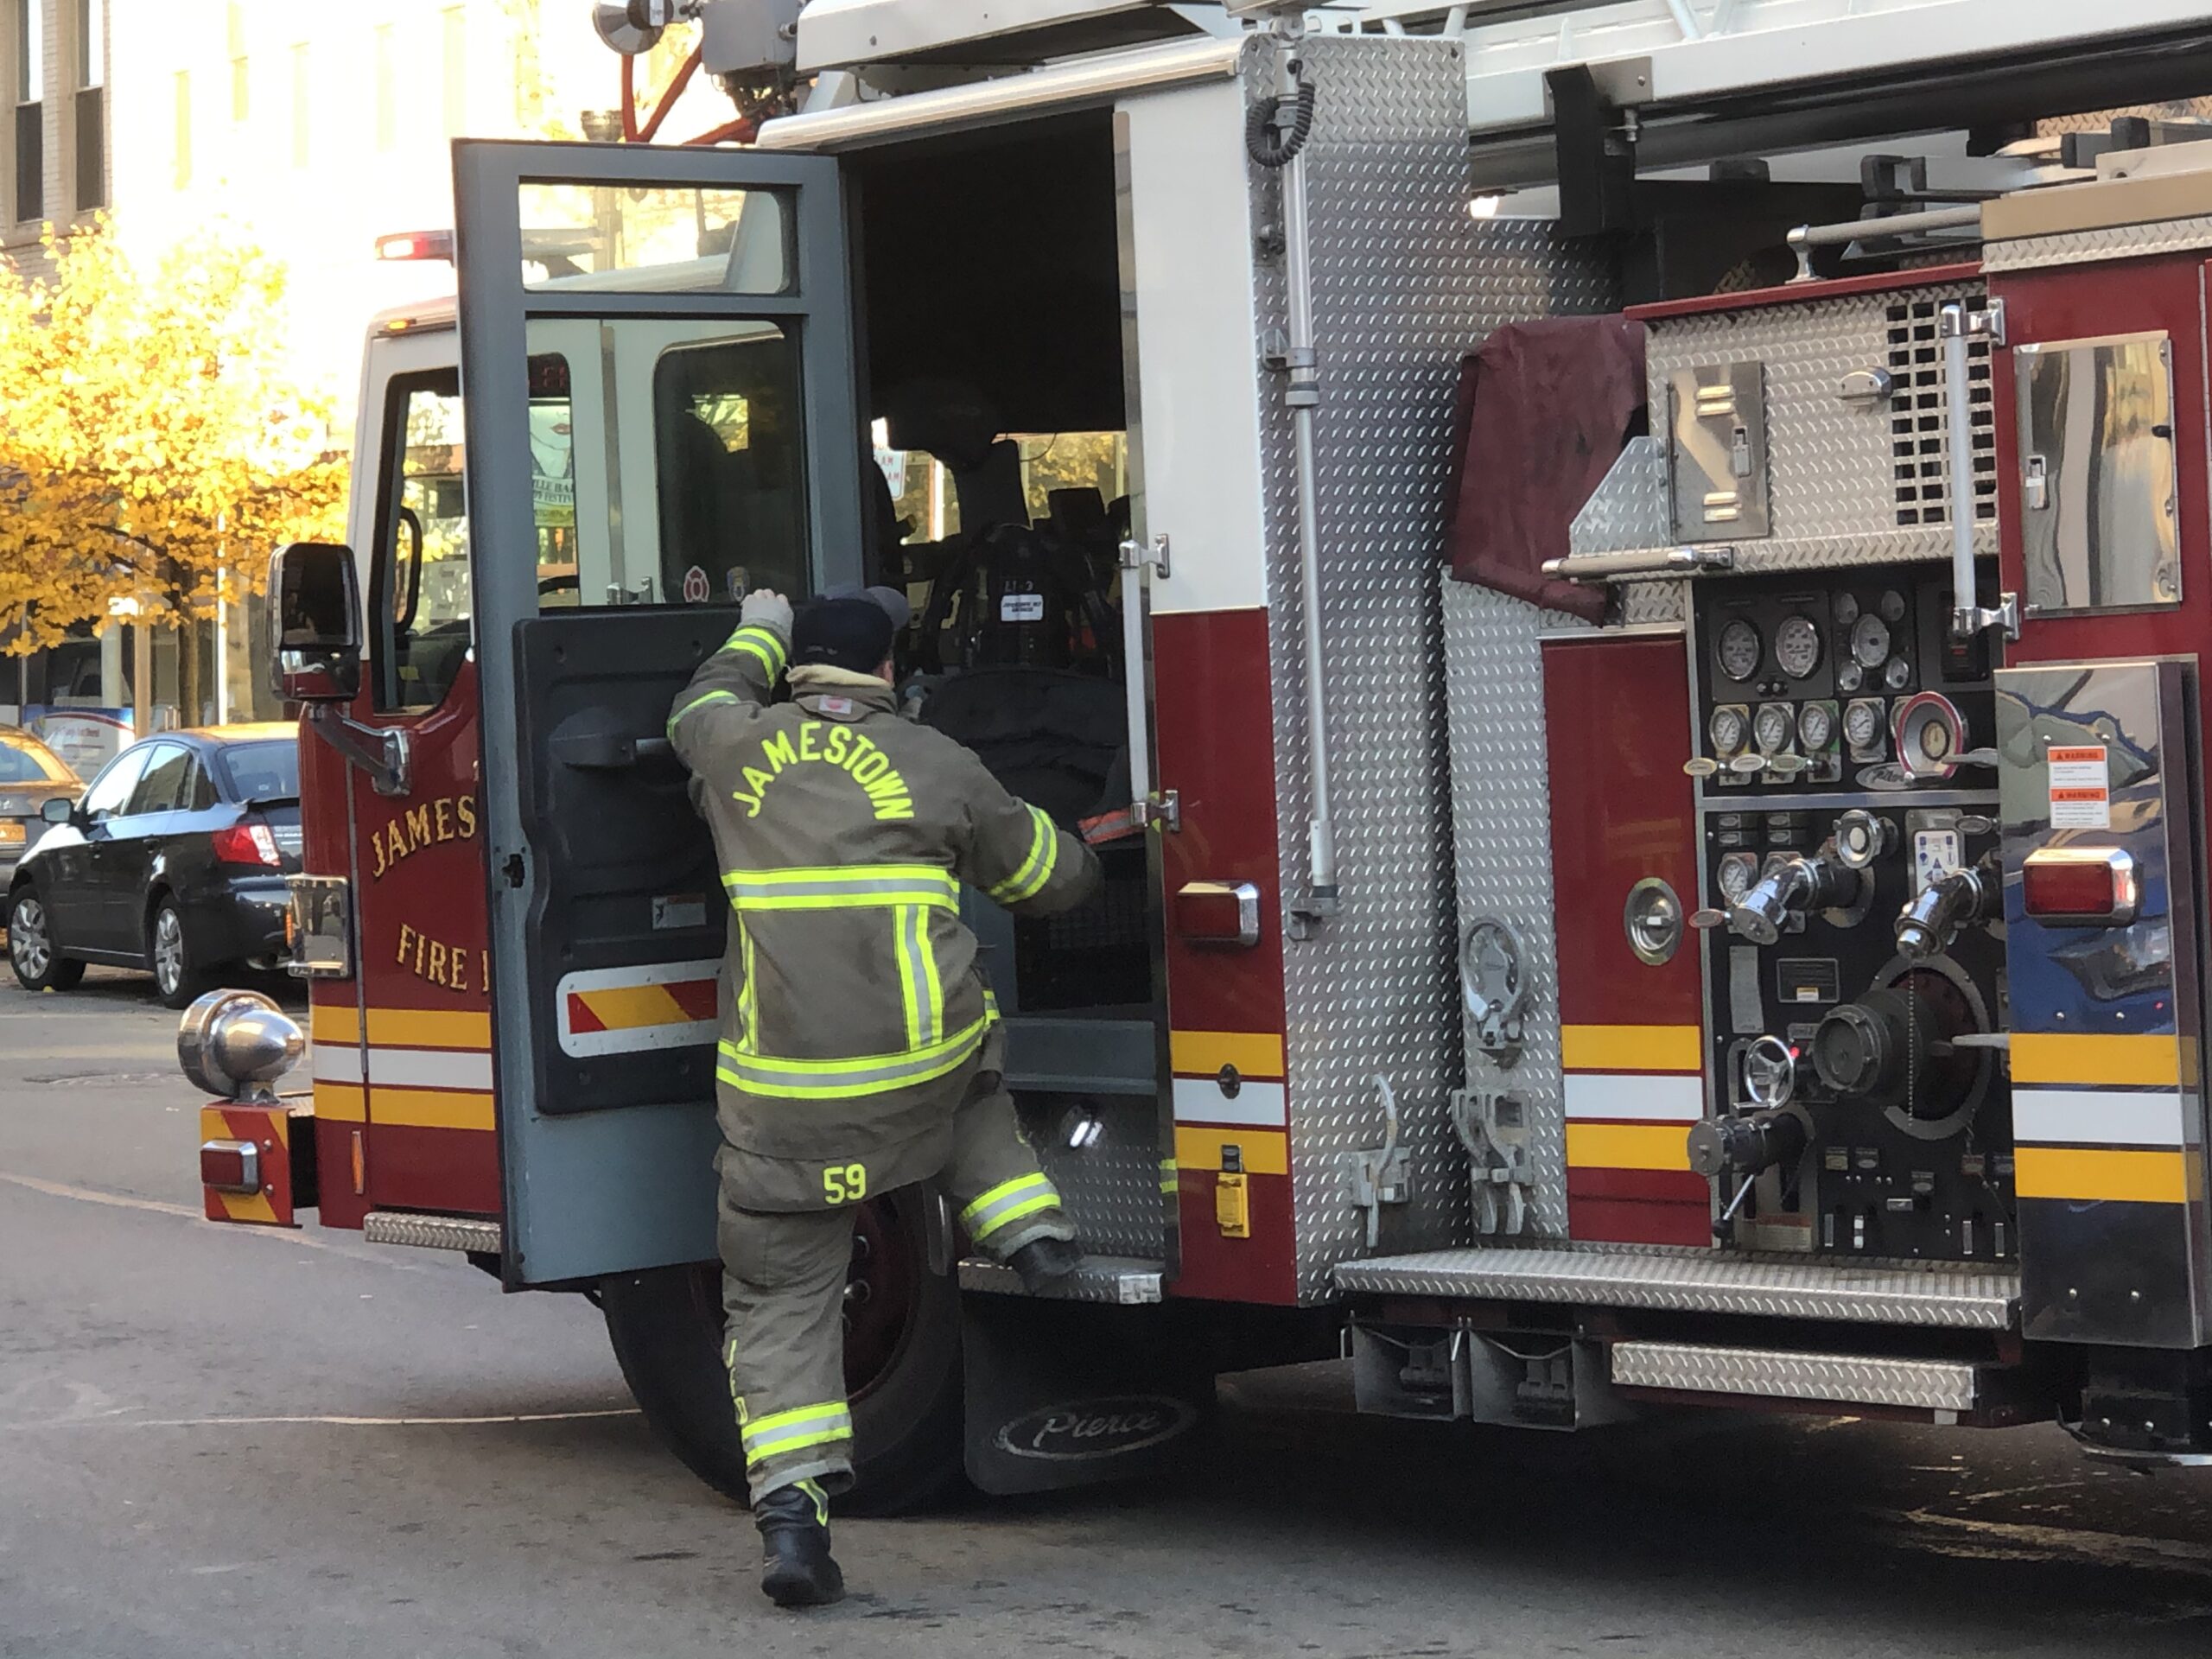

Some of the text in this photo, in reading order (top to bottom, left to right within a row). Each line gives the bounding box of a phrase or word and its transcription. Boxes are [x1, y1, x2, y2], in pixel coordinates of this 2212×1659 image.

[733, 721, 914, 820] JAMESTOWN
[397, 922, 467, 990] FIRE
[823, 1163, 866, 1204] 59
[1033, 1410, 1161, 1448] Pierce
